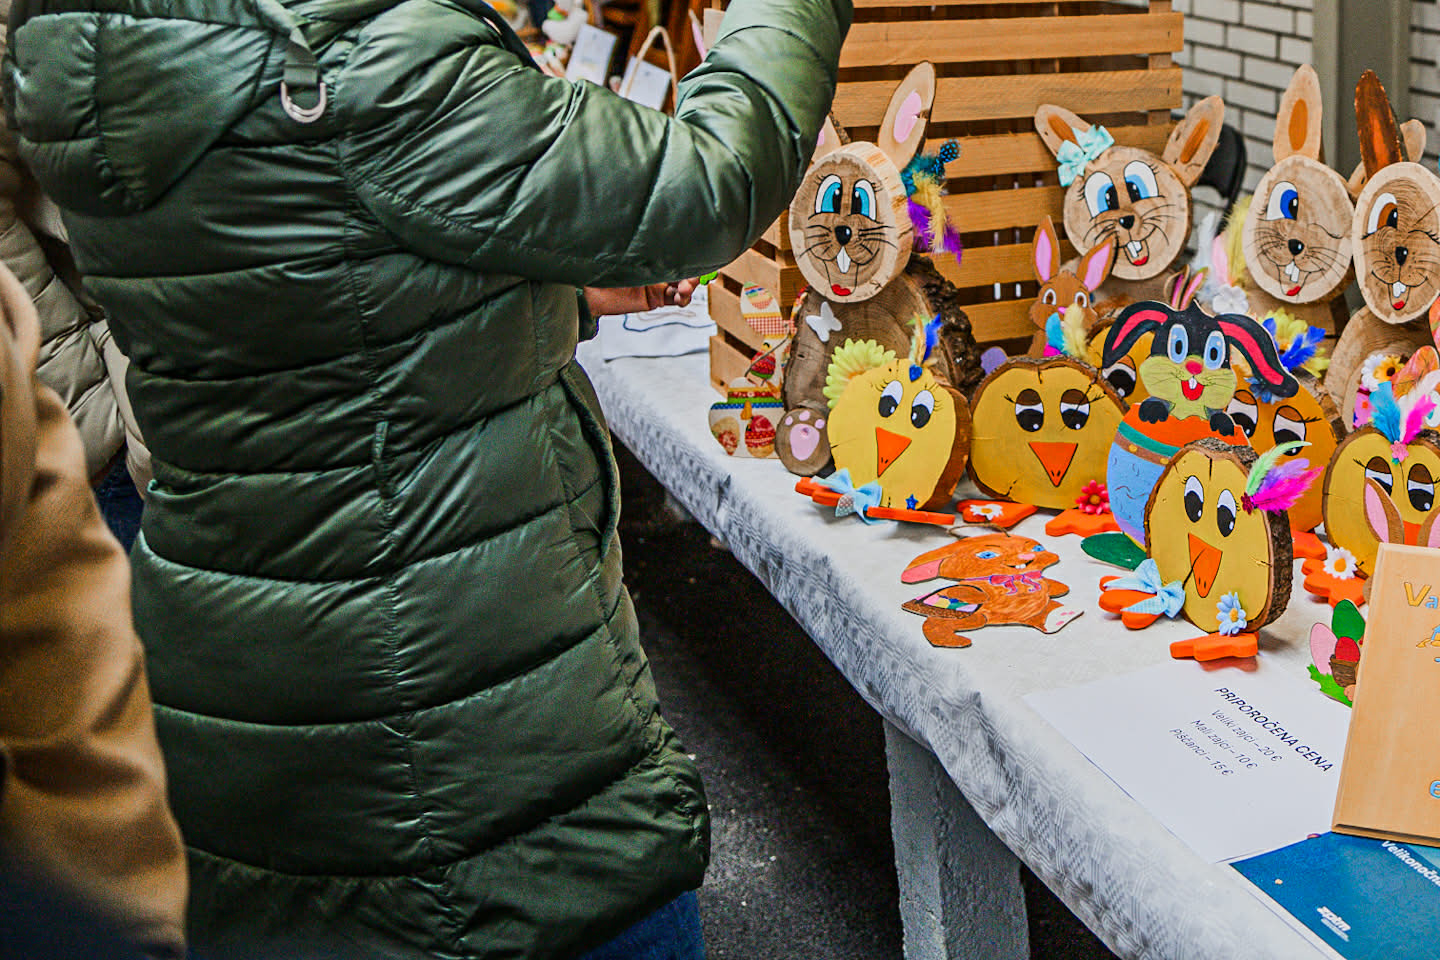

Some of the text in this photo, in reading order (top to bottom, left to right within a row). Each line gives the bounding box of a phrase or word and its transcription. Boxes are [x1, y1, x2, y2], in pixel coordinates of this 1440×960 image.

[1169, 727, 1208, 758] Piščanci
[1211, 759, 1227, 772] 15
[1221, 768, 1235, 777] €
[1190, 719, 1211, 736] Mali
[1207, 733, 1231, 751] zajci
[1235, 753, 1252, 765] 10
[1246, 761, 1259, 770] €
[1210, 709, 1237, 729] Veliki
[1232, 726, 1255, 744] zajci
[1258, 745, 1274, 758] 20
[1270, 754, 1283, 762] €
[1214, 686, 1335, 773] PRIPOROČENA CENA
